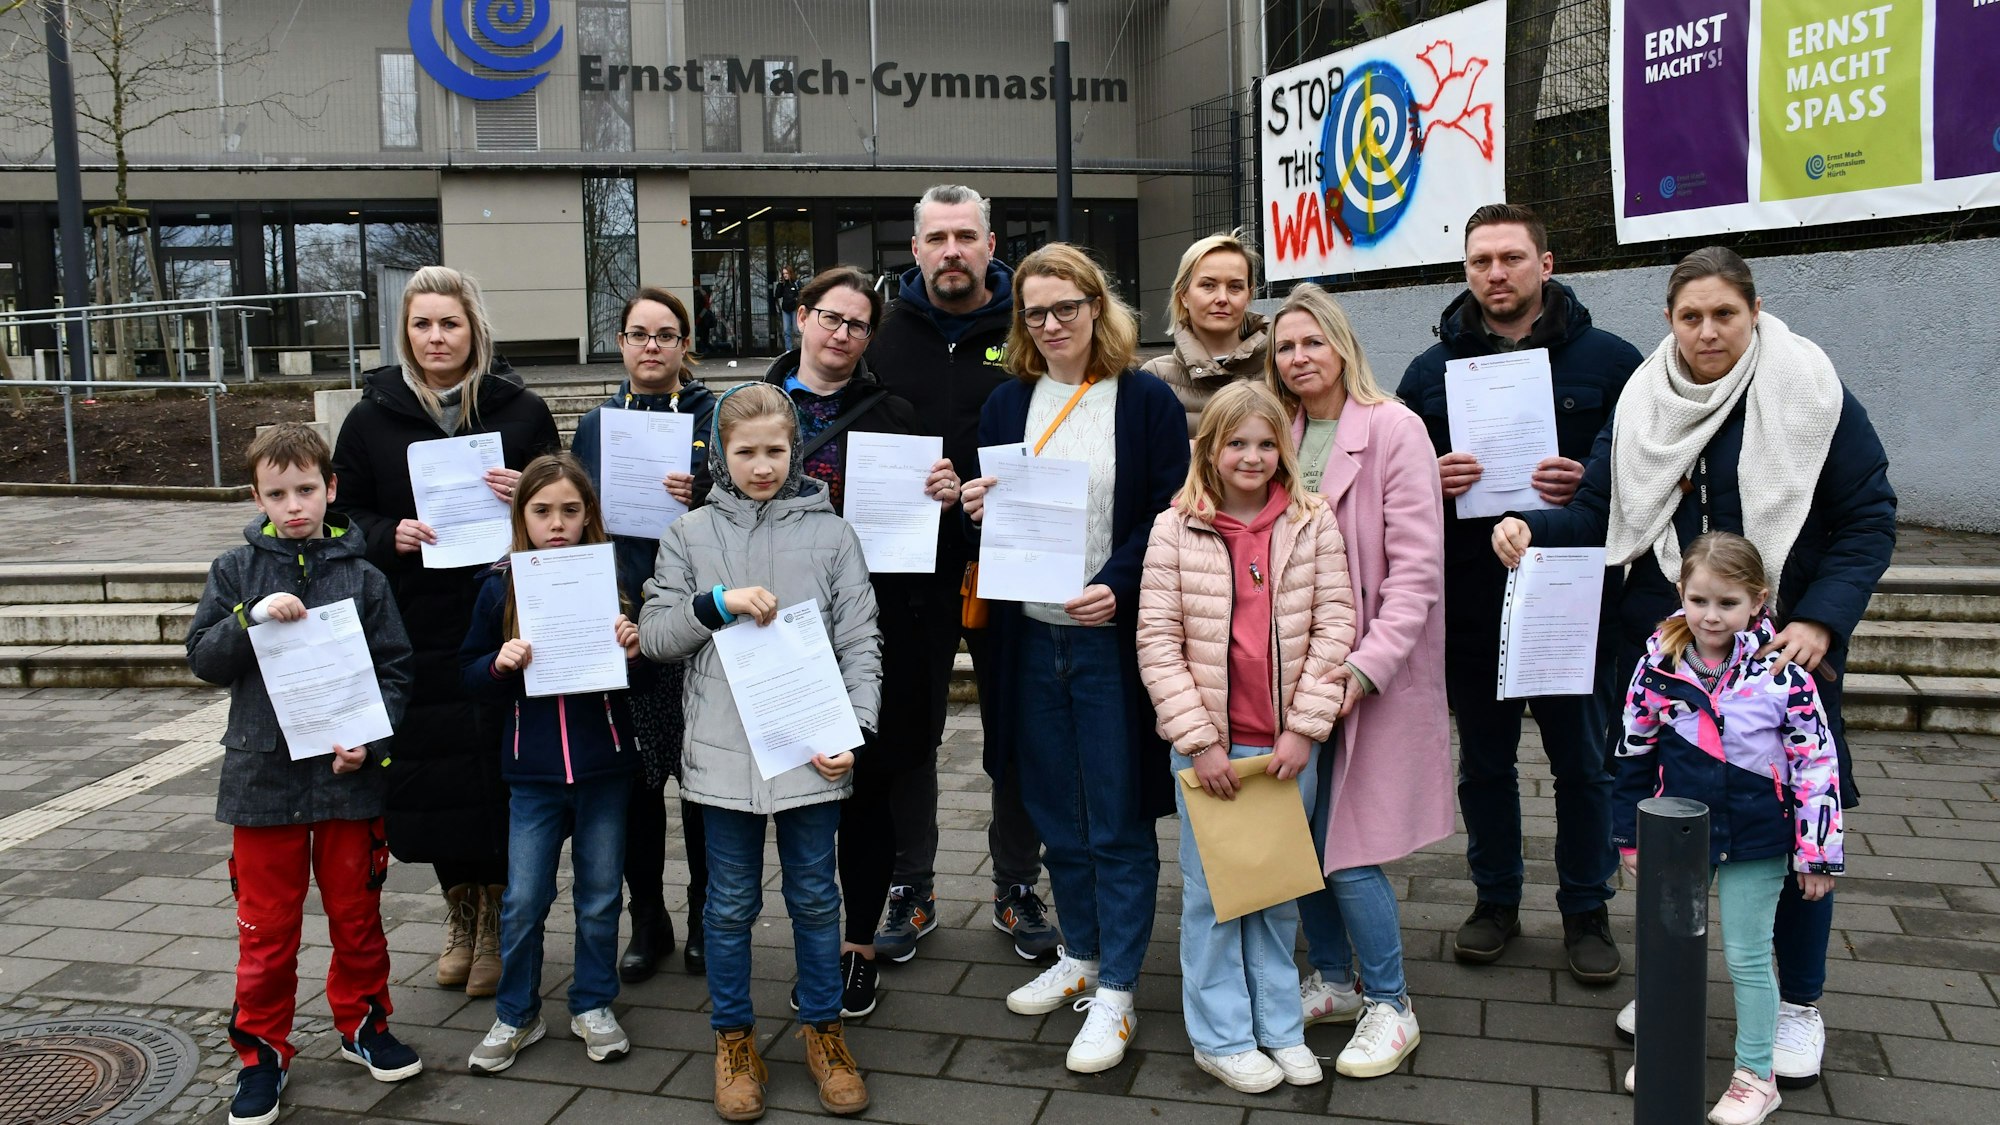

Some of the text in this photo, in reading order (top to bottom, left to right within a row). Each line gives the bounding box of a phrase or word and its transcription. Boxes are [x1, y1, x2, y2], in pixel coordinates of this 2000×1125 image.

[1645, 12, 1728, 61] ERNST
[1788, 4, 1893, 58] ERNST
[1787, 47, 1892, 93] MACHT
[1268, 66, 1344, 135] STOP
[1785, 85, 1887, 132] SPASS
[1827, 149, 1863, 161] Ernst Mach
[1827, 158, 1866, 170] Gymnasium
[1272, 187, 1353, 261] WAR
